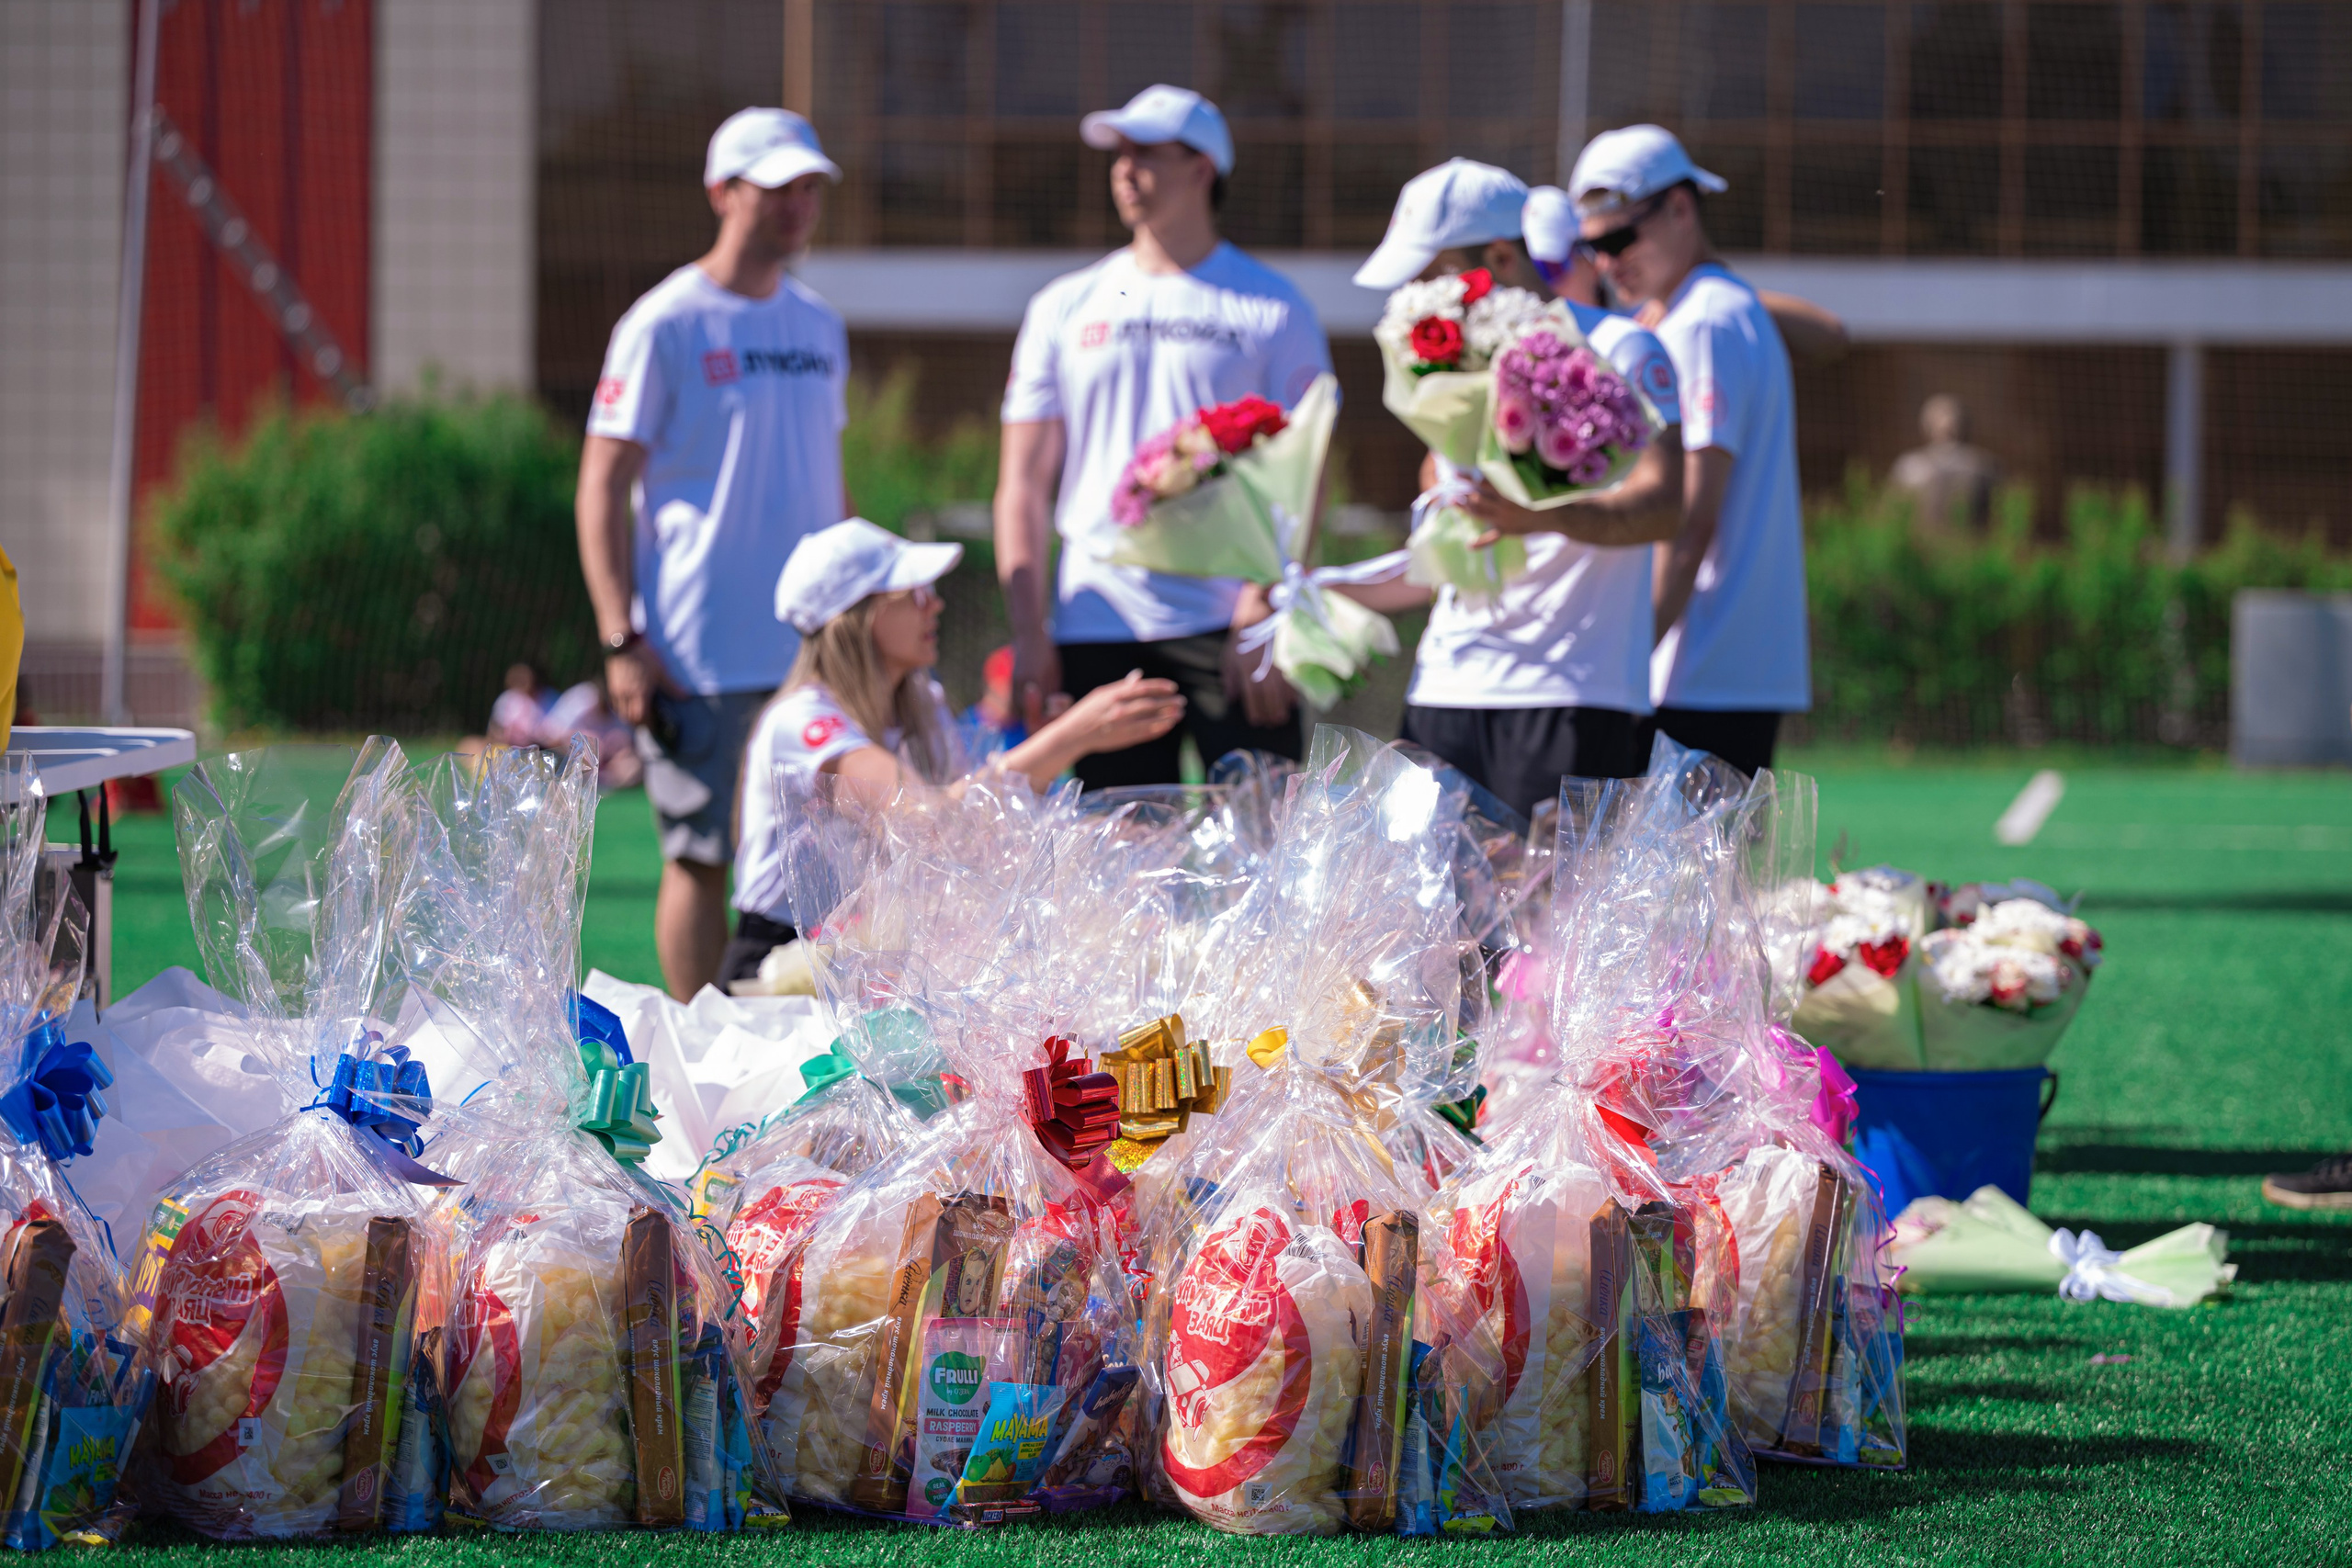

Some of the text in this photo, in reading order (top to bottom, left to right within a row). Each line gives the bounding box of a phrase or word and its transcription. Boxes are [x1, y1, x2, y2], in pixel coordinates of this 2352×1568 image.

[898, 1258, 922, 1310] Алёнка
[1383, 1274, 1406, 1323] Алёнка
[1598, 1269, 1615, 1316] Алёнка
[1186, 1310, 1230, 1346] ЗАЯЦ
[1599, 1326, 1608, 1345] вкус
[15, 1356, 27, 1377] вкус
[879, 1315, 903, 1411] вкус шоколадный крем
[934, 1367, 978, 1384] FRULLI
[362, 1338, 379, 1436] вкус шоколадный крем
[651, 1338, 665, 1436] вкус шоколадный крем
[1374, 1333, 1390, 1429] вкус шоколадный крем
[2, 1376, 24, 1433] шоколадный
[926, 1407, 979, 1418] MILK CHOCOLATE
[1599, 1398, 1607, 1420] крем
[929, 1420, 977, 1433] RASPBERRY
[989, 1412, 1048, 1444] MAYAMA
[199, 1489, 223, 1499] Масса
[1211, 1504, 1235, 1517] Масса
